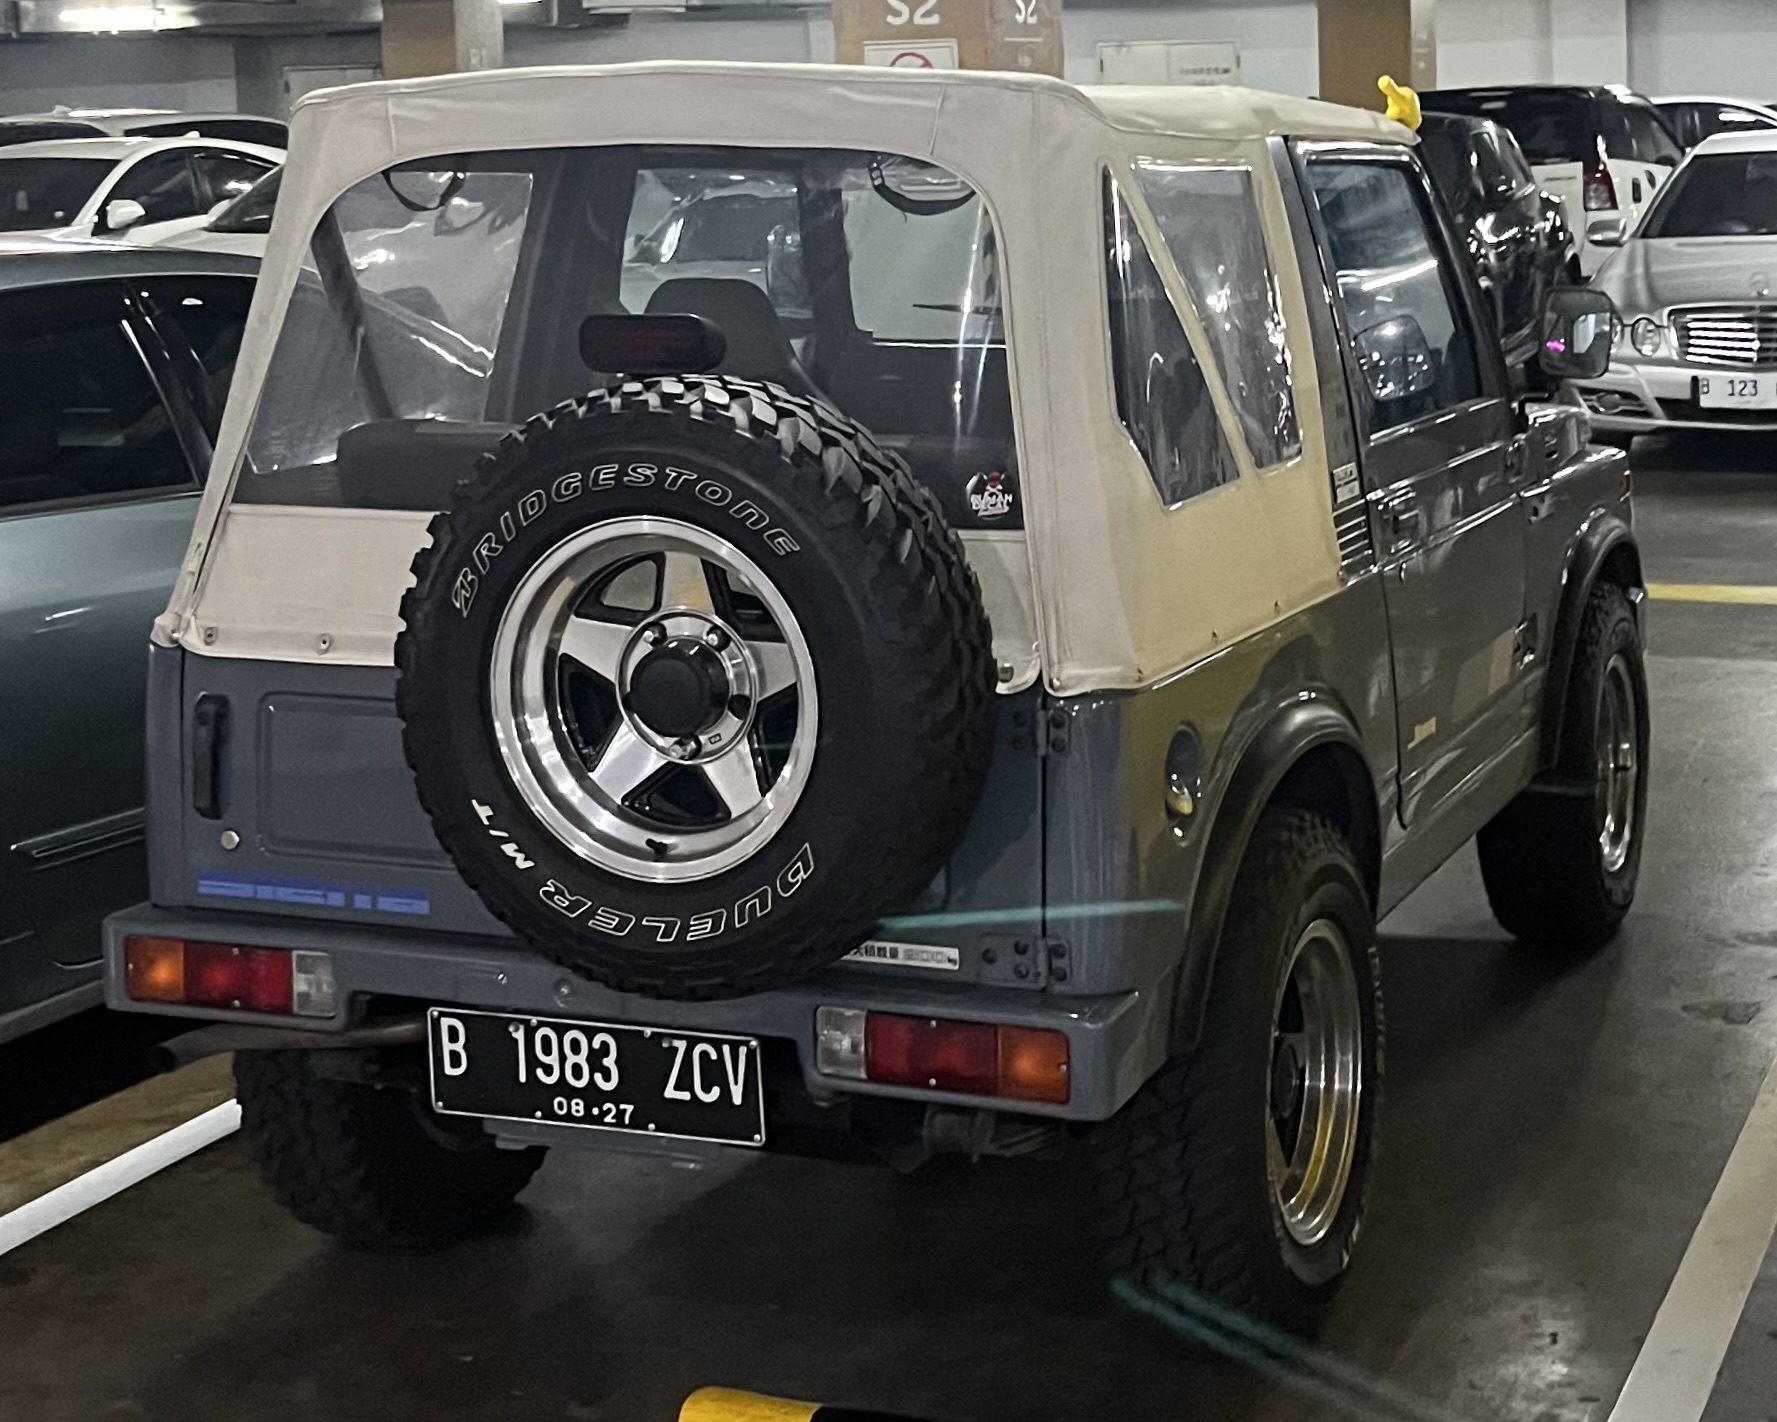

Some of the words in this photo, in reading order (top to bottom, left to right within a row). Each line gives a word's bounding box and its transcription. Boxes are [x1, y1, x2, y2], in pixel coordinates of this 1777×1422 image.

[1728, 379, 1758, 397] 123
[452, 463, 801, 618] BRIDGESTONE
[471, 799, 535, 870] M/T
[539, 842, 814, 942] DUELER
[440, 1017, 468, 1076] B
[511, 1023, 619, 1091] 1983
[662, 1039, 748, 1106] ZCV
